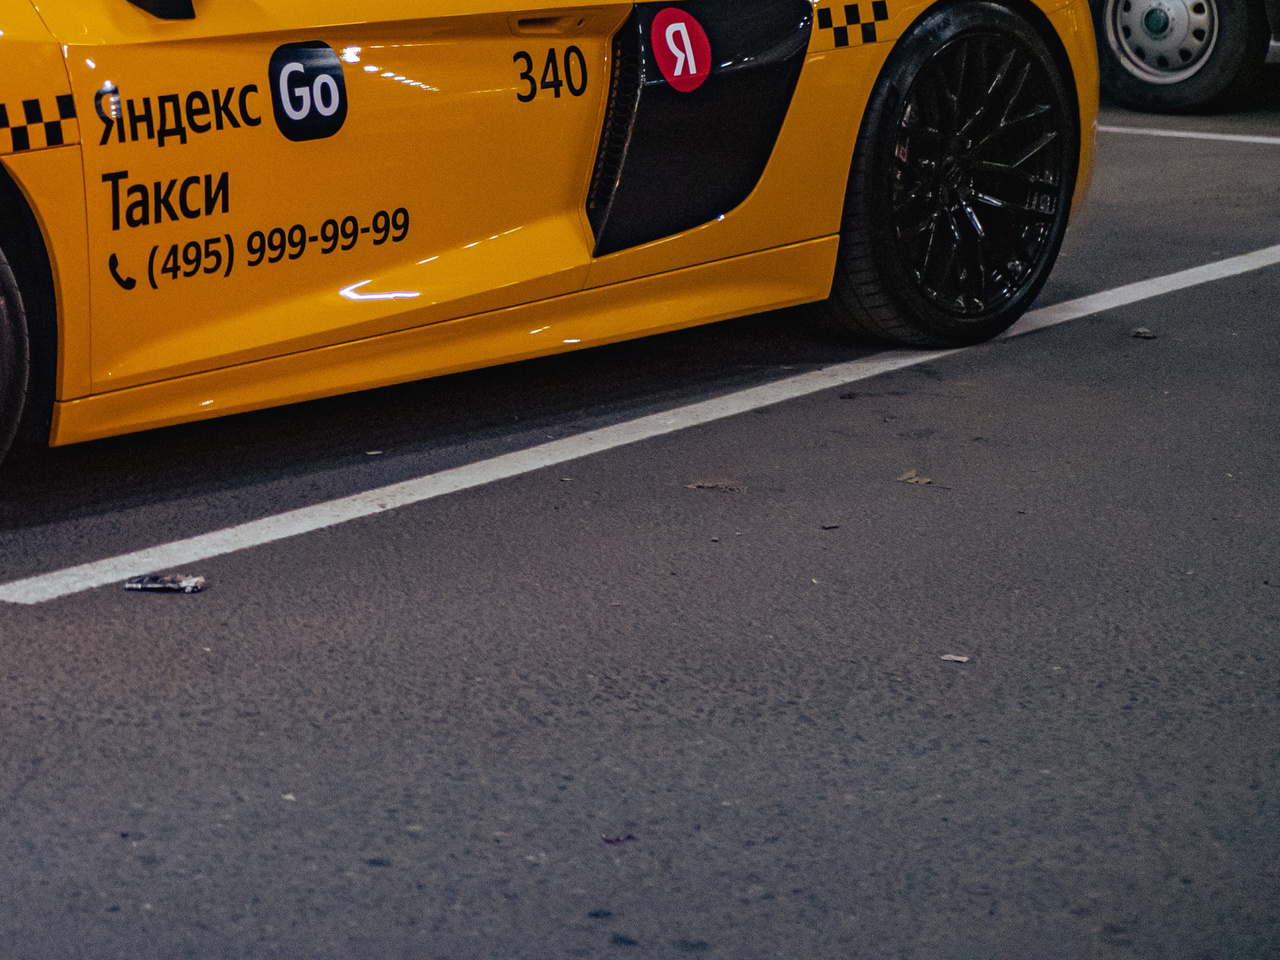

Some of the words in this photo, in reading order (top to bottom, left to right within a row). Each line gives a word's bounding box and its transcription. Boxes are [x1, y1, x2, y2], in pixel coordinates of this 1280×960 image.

[512, 45, 588, 103] 340
[665, 22, 697, 76] Я
[94, 83, 262, 147] Яндекс
[279, 62, 340, 120] Go
[101, 170, 230, 231] Такси
[147, 233, 235, 290] (495)
[246, 207, 410, 267] 999-99-99
